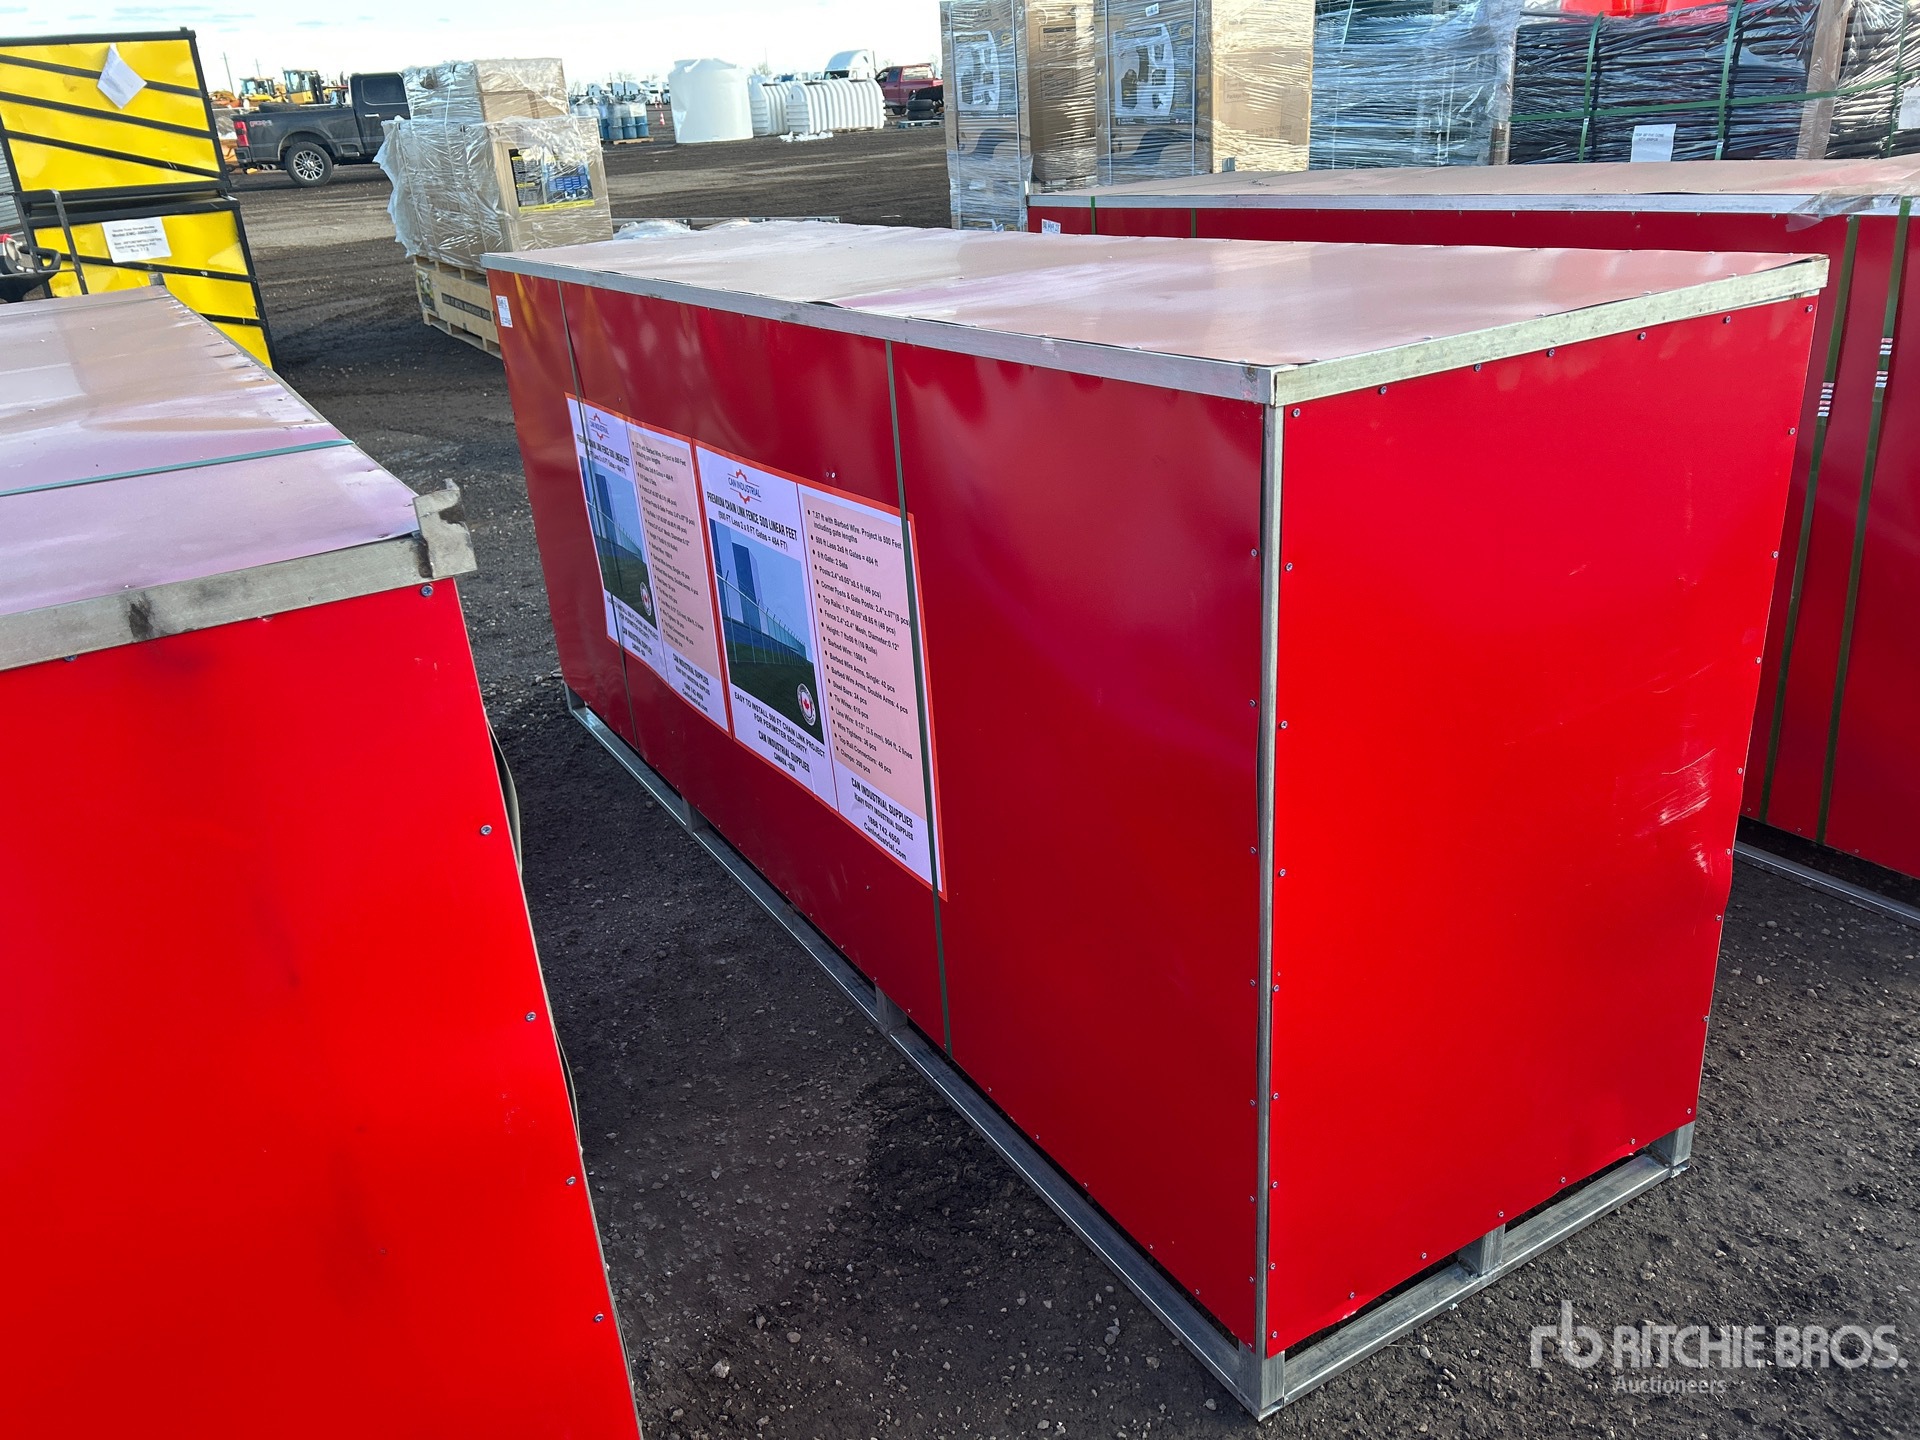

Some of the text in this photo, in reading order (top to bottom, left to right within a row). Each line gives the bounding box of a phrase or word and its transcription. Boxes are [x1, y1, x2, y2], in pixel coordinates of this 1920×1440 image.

[728, 477, 761, 498] CAN INDUSTRIAL
[707, 491, 725, 508] PREMIUM
[725, 499, 736, 513] CHAIN
[736, 505, 746, 518] LINK
[746, 509, 759, 524] FENCE
[768, 519, 785, 536] LINEAR
[785, 526, 798, 541] FEET
[740, 521, 744, 530] 2
[750, 526, 755, 535] FT
[834, 518, 849, 530] Barbed
[861, 528, 878, 540] Project
[887, 684, 895, 693] pcs
[900, 706, 908, 714] pcs
[752, 703, 768, 719] INSTALL
[777, 718, 781, 727] FT
[783, 723, 795, 736] CHAIN
[796, 733, 805, 744] LINK
[806, 739, 825, 759] PROJECT
[754, 713, 807, 754] FOR PERIMETER SECURITY
[758, 730, 810, 773] CAN INDUSTRIAL SUPPLIES
[851, 778, 913, 828] CAN INDUSTRIAL SUPPLIES
[895, 822, 914, 841] SUPPLIES
